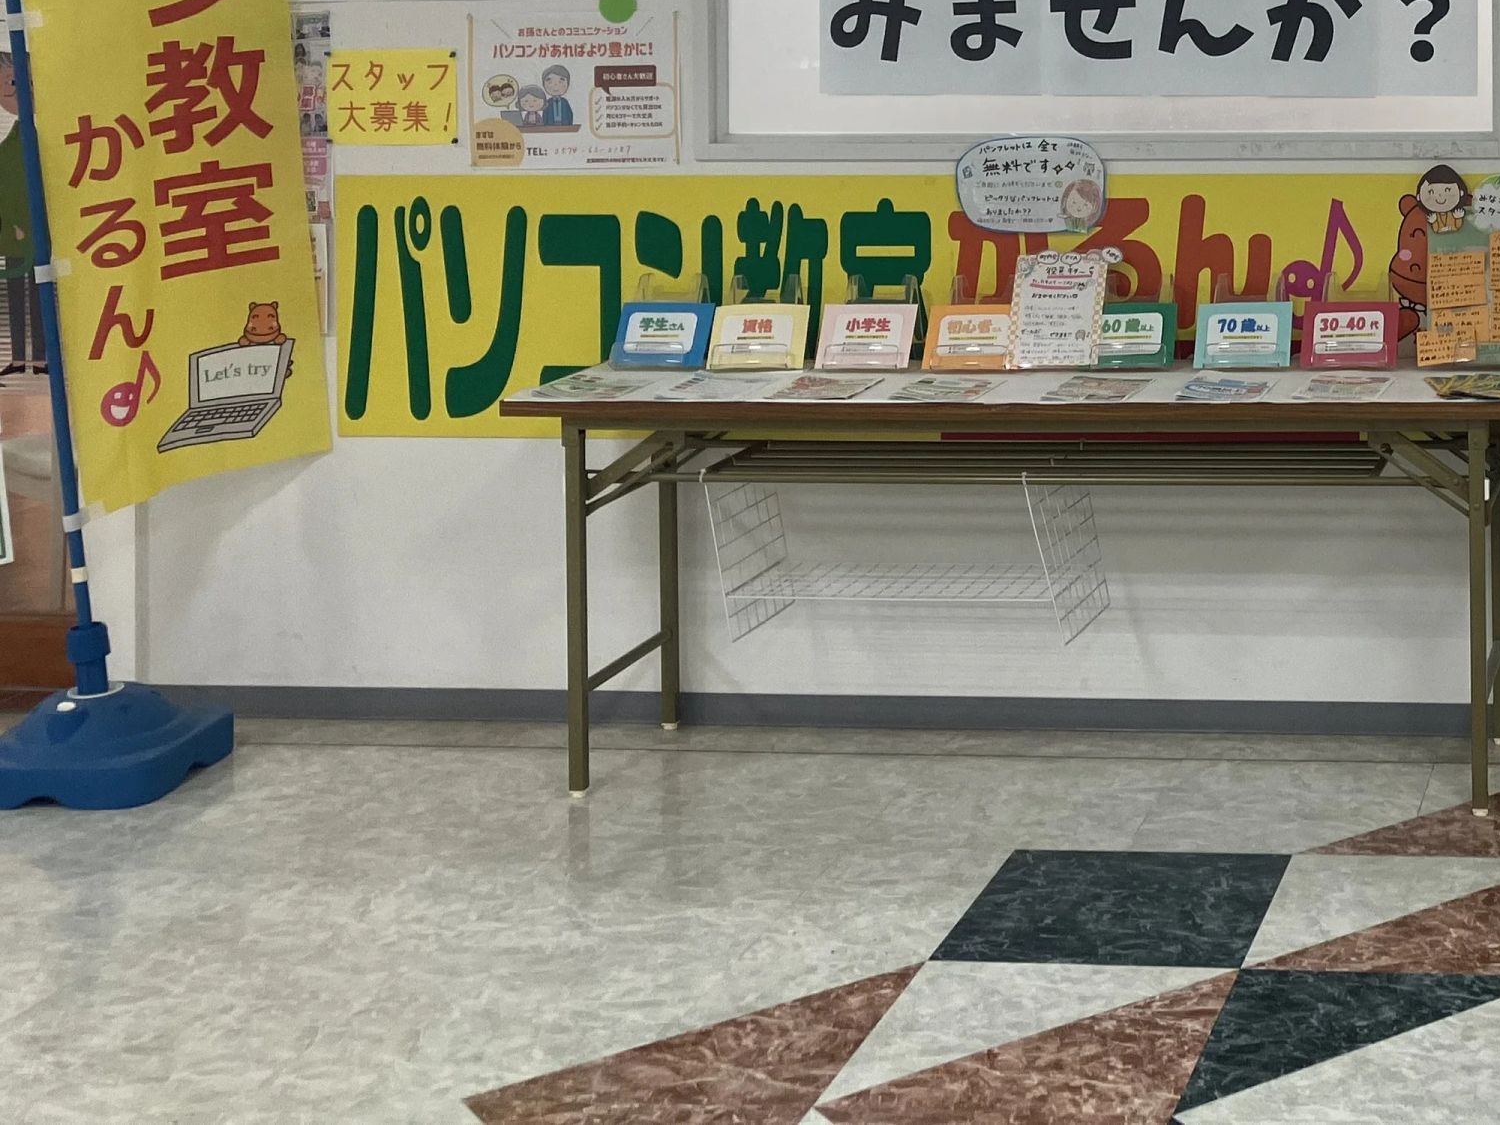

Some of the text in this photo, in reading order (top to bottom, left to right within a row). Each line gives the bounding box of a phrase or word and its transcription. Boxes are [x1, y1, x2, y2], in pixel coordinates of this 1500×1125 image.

[517, 25, 628, 38] お孫さんとのコミュニケーション
[332, 61, 451, 92] スタッフ
[982, 156, 1050, 177] 無料です
[639, 316, 685, 331] 学生さん
[742, 318, 773, 334] 資格
[845, 317, 891, 332] 小学生
[1217, 317, 1270, 333] 70歳以上
[204, 362, 272, 383] Let's try
